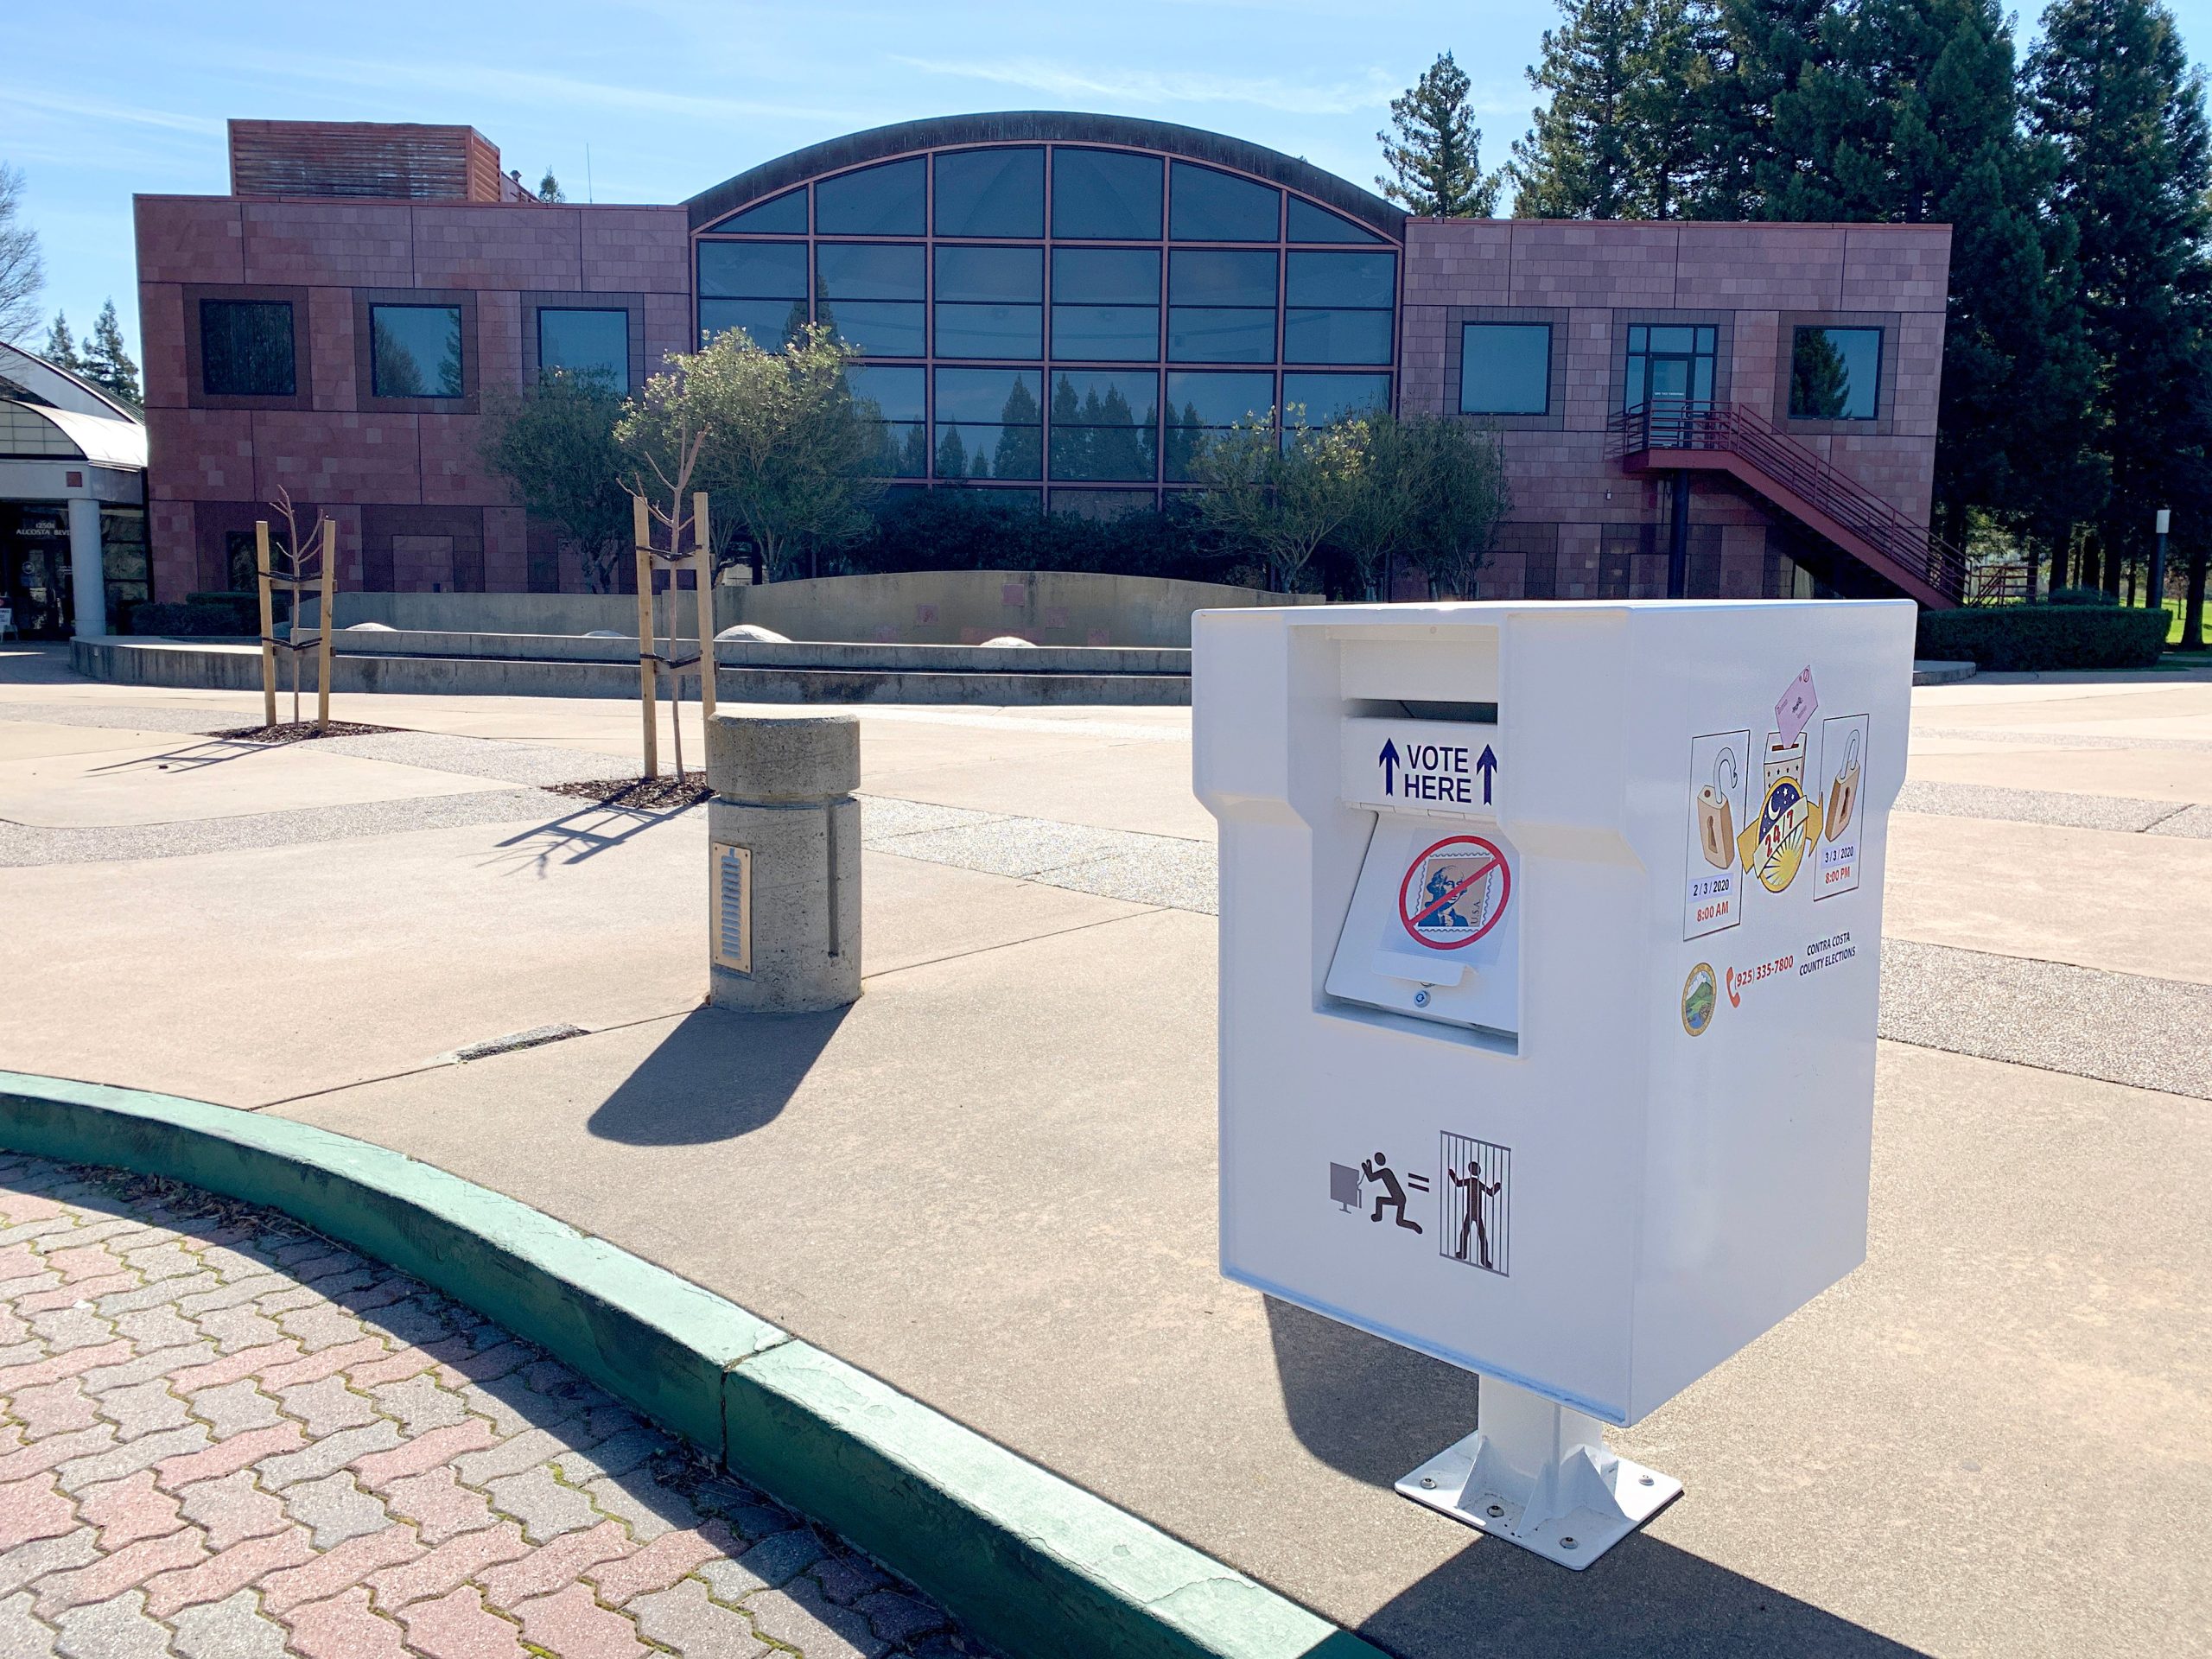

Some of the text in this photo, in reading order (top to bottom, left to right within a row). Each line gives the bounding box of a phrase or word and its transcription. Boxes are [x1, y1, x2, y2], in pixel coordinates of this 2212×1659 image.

[1407, 744, 1469, 773] VOTE
[1404, 773, 1471, 804] HERE
[1764, 809, 1794, 858] 24/7
[1825, 866, 1851, 884] 8:00 PM
[1697, 900, 1729, 922] 8:00 AM
[1807, 931, 1851, 957] CONTRA COSTA
[1734, 955, 1794, 990] (925) 335-7800
[1799, 945, 1856, 976] COUNTY ELECTIONS
